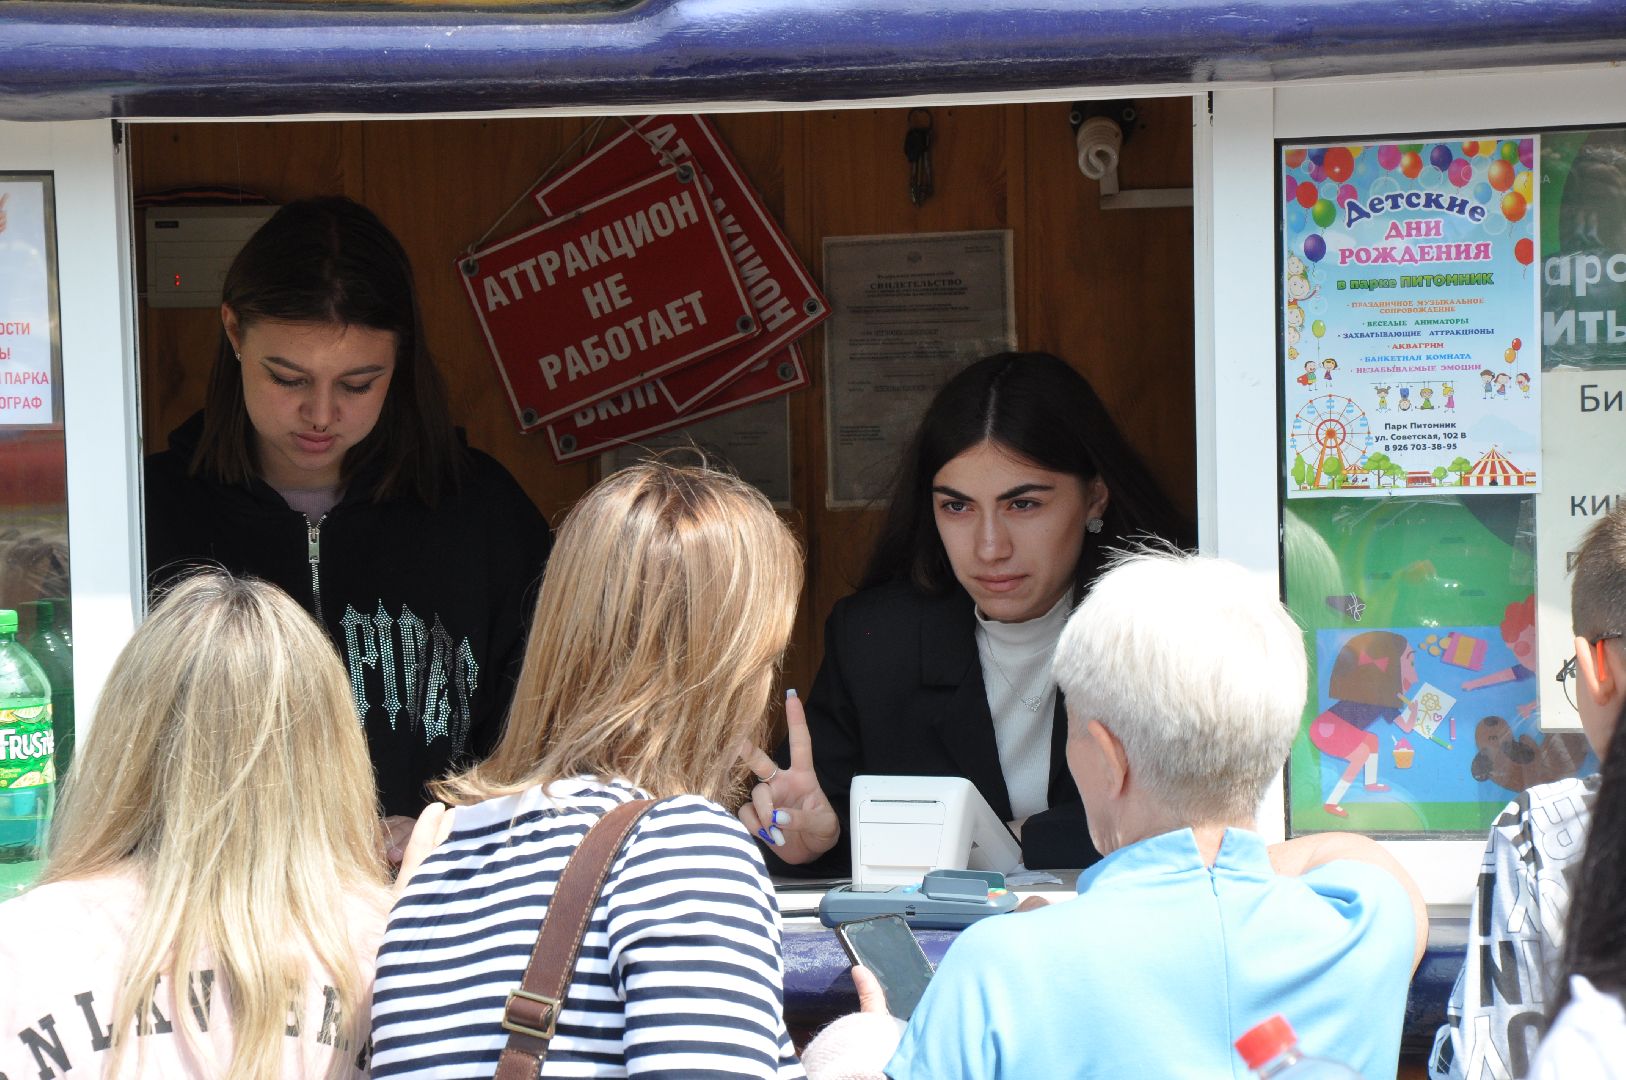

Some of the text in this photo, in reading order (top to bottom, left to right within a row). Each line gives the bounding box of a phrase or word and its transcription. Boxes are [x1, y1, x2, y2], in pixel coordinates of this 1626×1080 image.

[1346, 192, 1486, 228] Детские
[1385, 220, 1442, 241] ДНИ
[482, 190, 699, 312] АТТРАКЦИОН
[1339, 242, 1491, 265] РОЖДЕНИЯ
[1337, 273, 1494, 291] в парке ПИТОМНИК
[582, 272, 633, 319] НЕ
[1414, 318, 1469, 326] АНИМАТОРЫ
[1342, 328, 1494, 339] ЗАХВАТЫВАЮЩИЕ АТТРАКЦИОНЫ
[538, 290, 709, 391] РАБОТАЕТ
[1392, 342, 1444, 350] АКВАГРИМ
[1426, 353, 1471, 361] КОМНАТА
[1440, 364, 1482, 372] ЭМОЦИИ
[5, 371, 49, 384] ПАРКА
[1384, 422, 1408, 431] Парк
[1390, 433, 1441, 441] Советская,
[1410, 443, 1458, 451] 703-38-95
